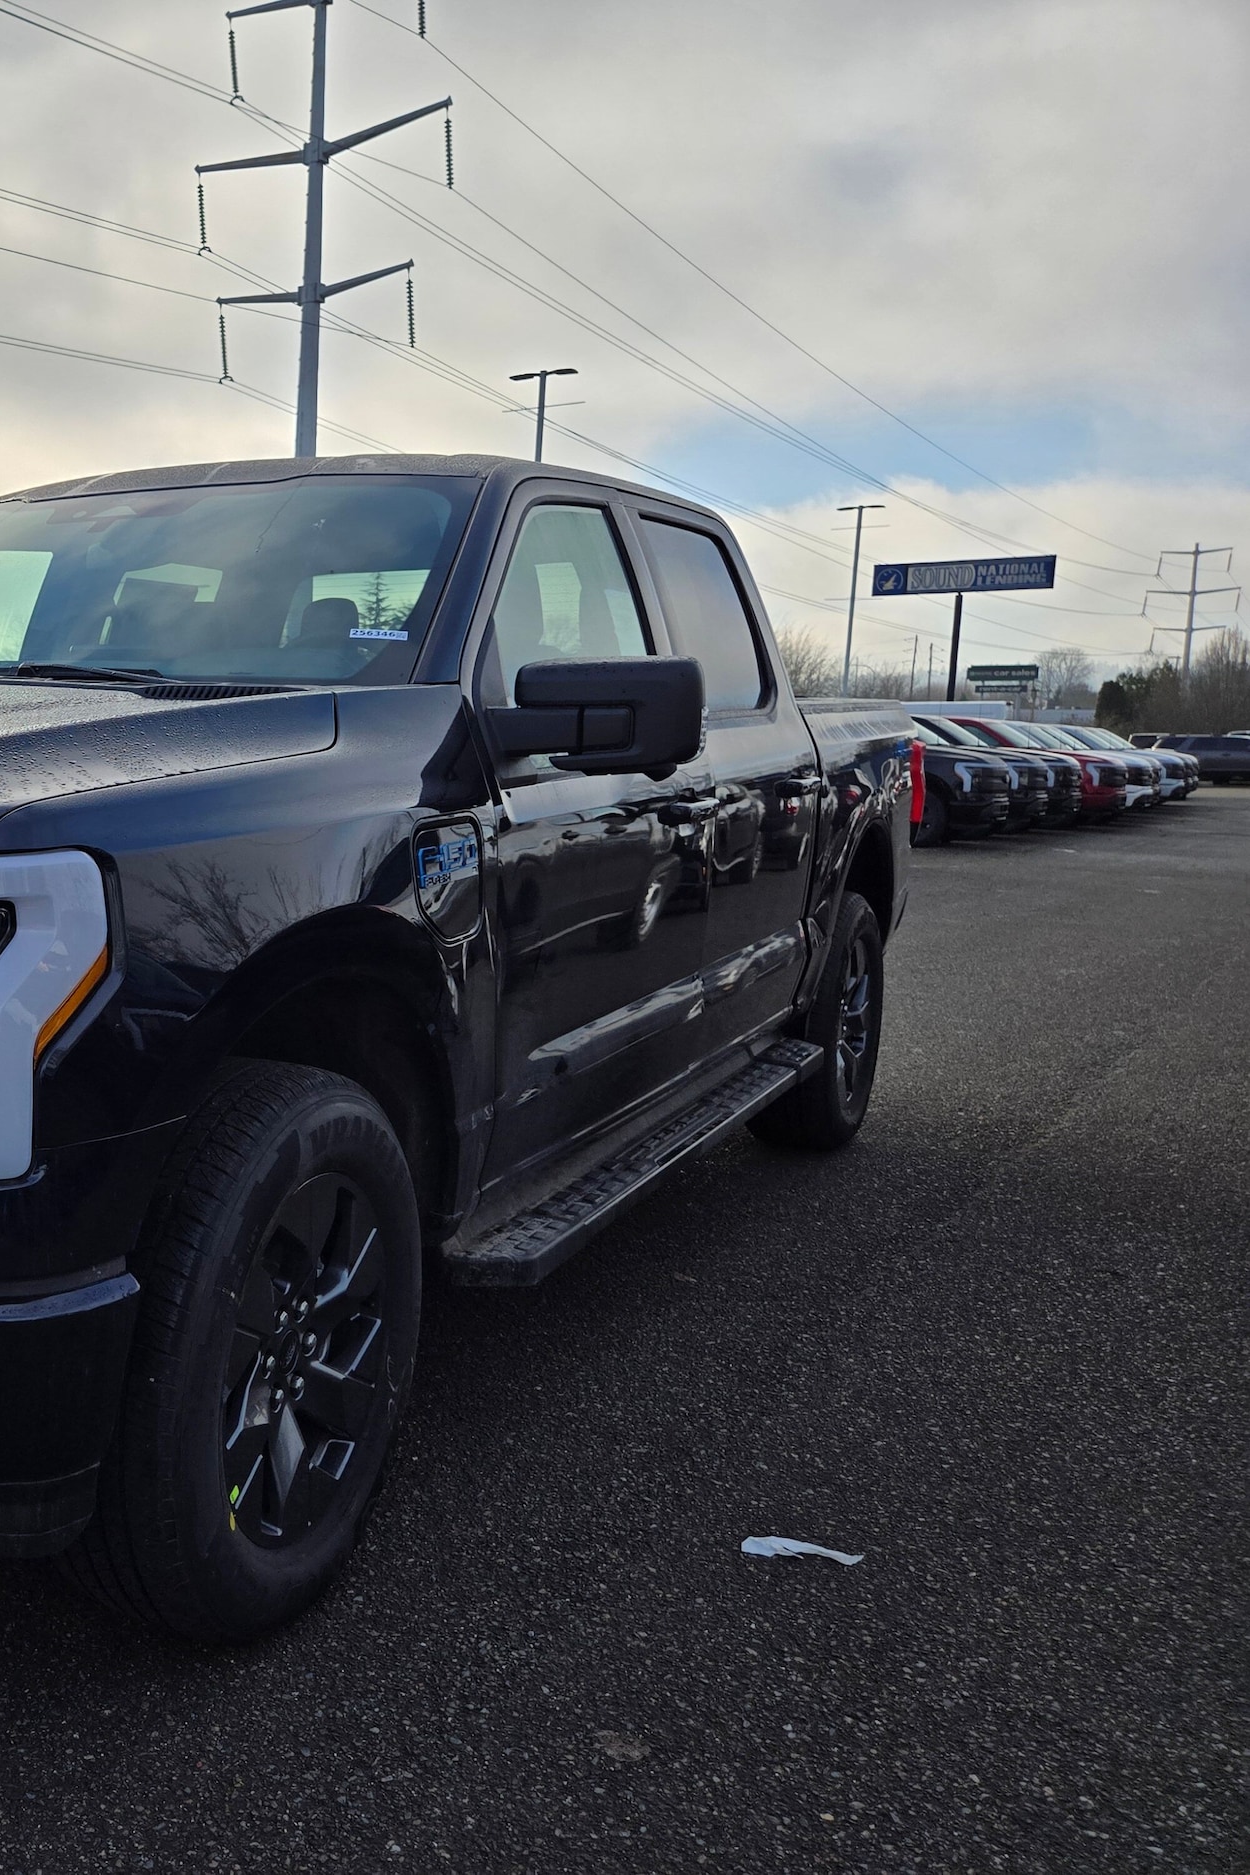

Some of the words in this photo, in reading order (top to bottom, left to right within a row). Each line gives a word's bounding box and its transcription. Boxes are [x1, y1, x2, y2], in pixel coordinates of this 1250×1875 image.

[977, 562, 1046, 576] NATIONAL
[910, 565, 973, 589] SOUND
[977, 573, 1046, 585] LENDING
